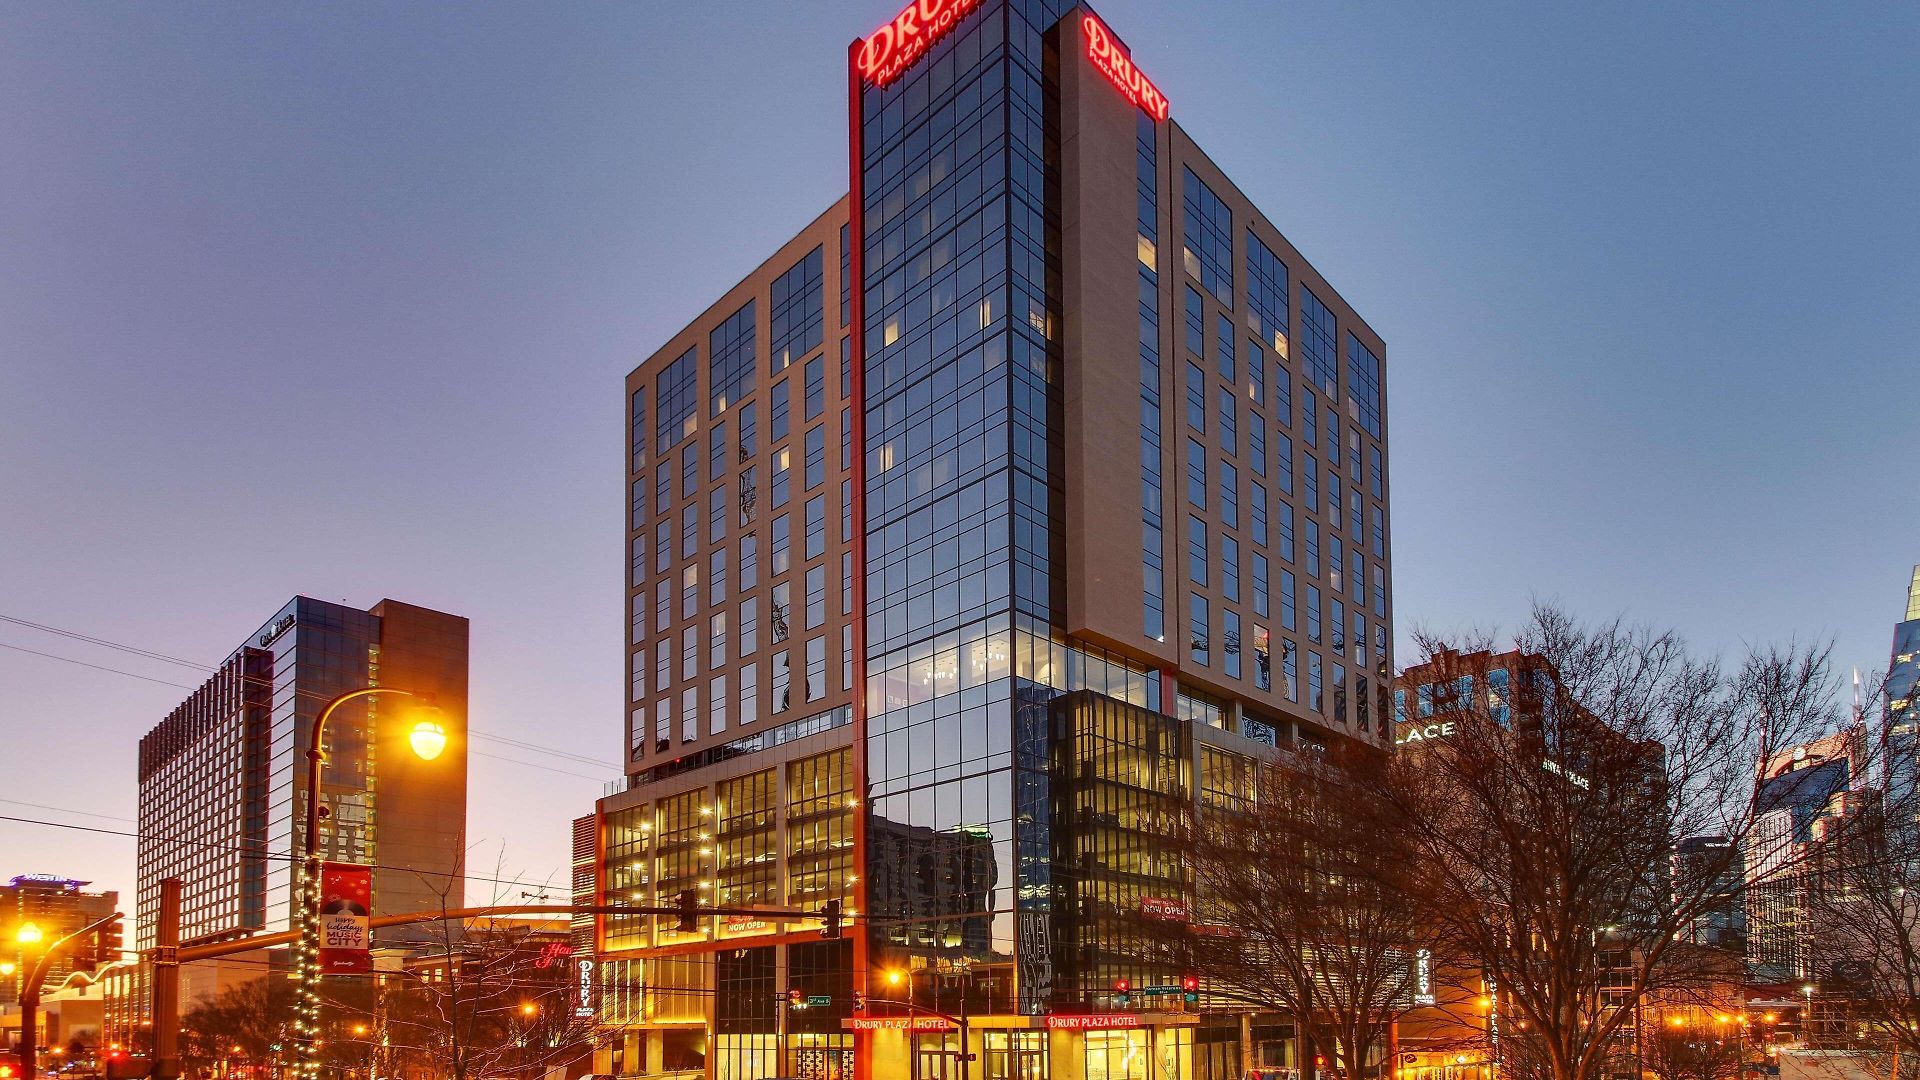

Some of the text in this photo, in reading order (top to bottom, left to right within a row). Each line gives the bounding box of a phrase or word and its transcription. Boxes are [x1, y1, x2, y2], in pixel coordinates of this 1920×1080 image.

[878, 0, 981, 85] PLAZA HOTE
[1084, 17, 1167, 119] DRURY
[1089, 46, 1137, 104] PLAZA HOTEL
[1143, 904, 1185, 916] NOW OPEN
[728, 922, 746, 932] NOW
[327, 938, 362, 946] CITY
[578, 960, 594, 1007] DRURY
[853, 1020, 884, 1029] DRURY
[917, 1020, 950, 1029] HOTEL
[1048, 1017, 1138, 1028] DRURY PLAZA HOTEL
